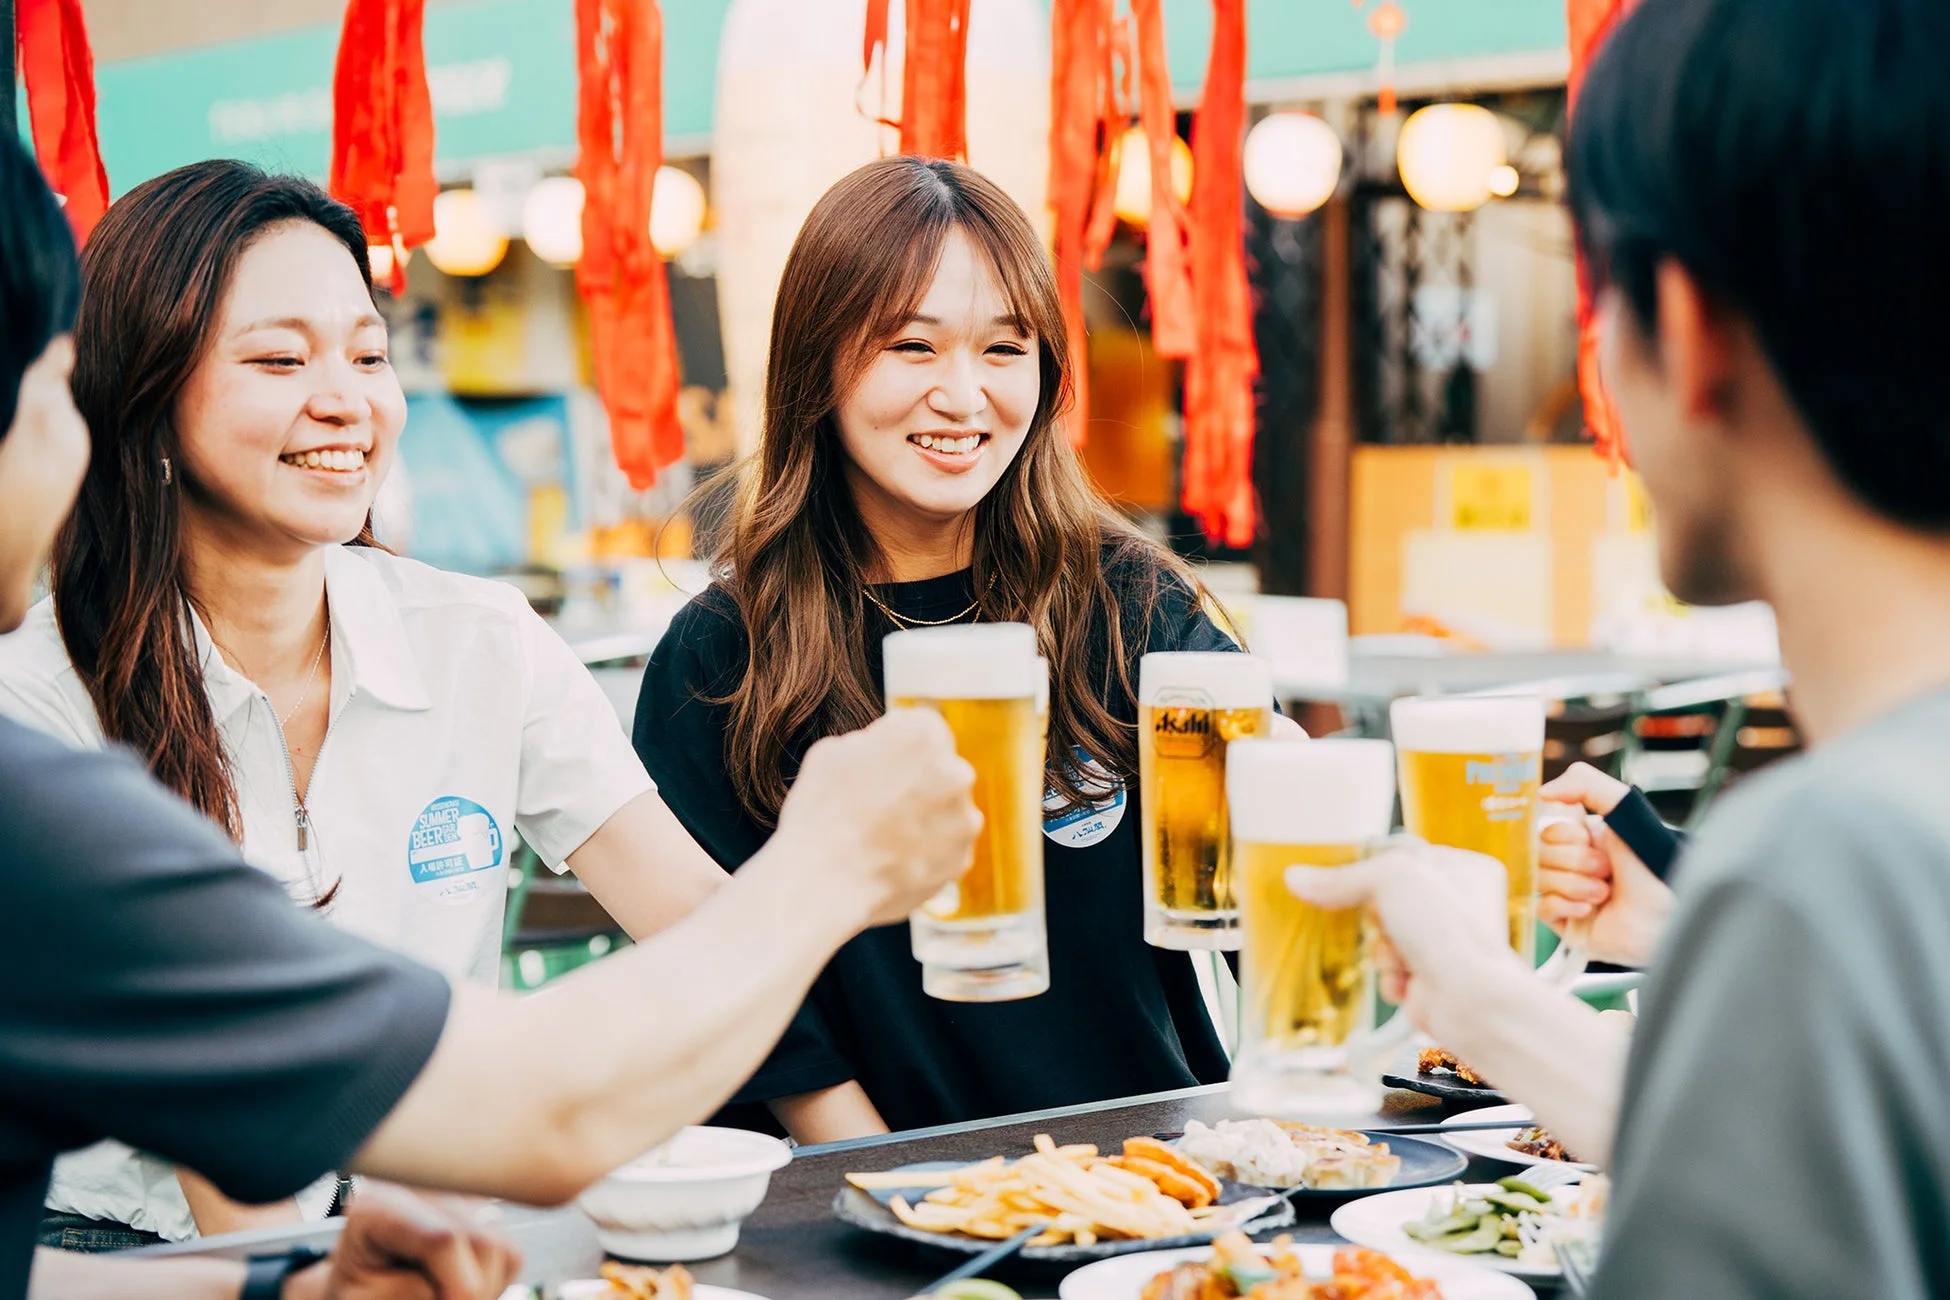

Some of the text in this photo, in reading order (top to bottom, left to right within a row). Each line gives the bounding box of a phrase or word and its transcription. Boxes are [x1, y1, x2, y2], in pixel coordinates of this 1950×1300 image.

[1156, 711, 1210, 735] Asahi
[419, 808, 460, 829] SUMMER
[412, 828, 444, 849] BEER
